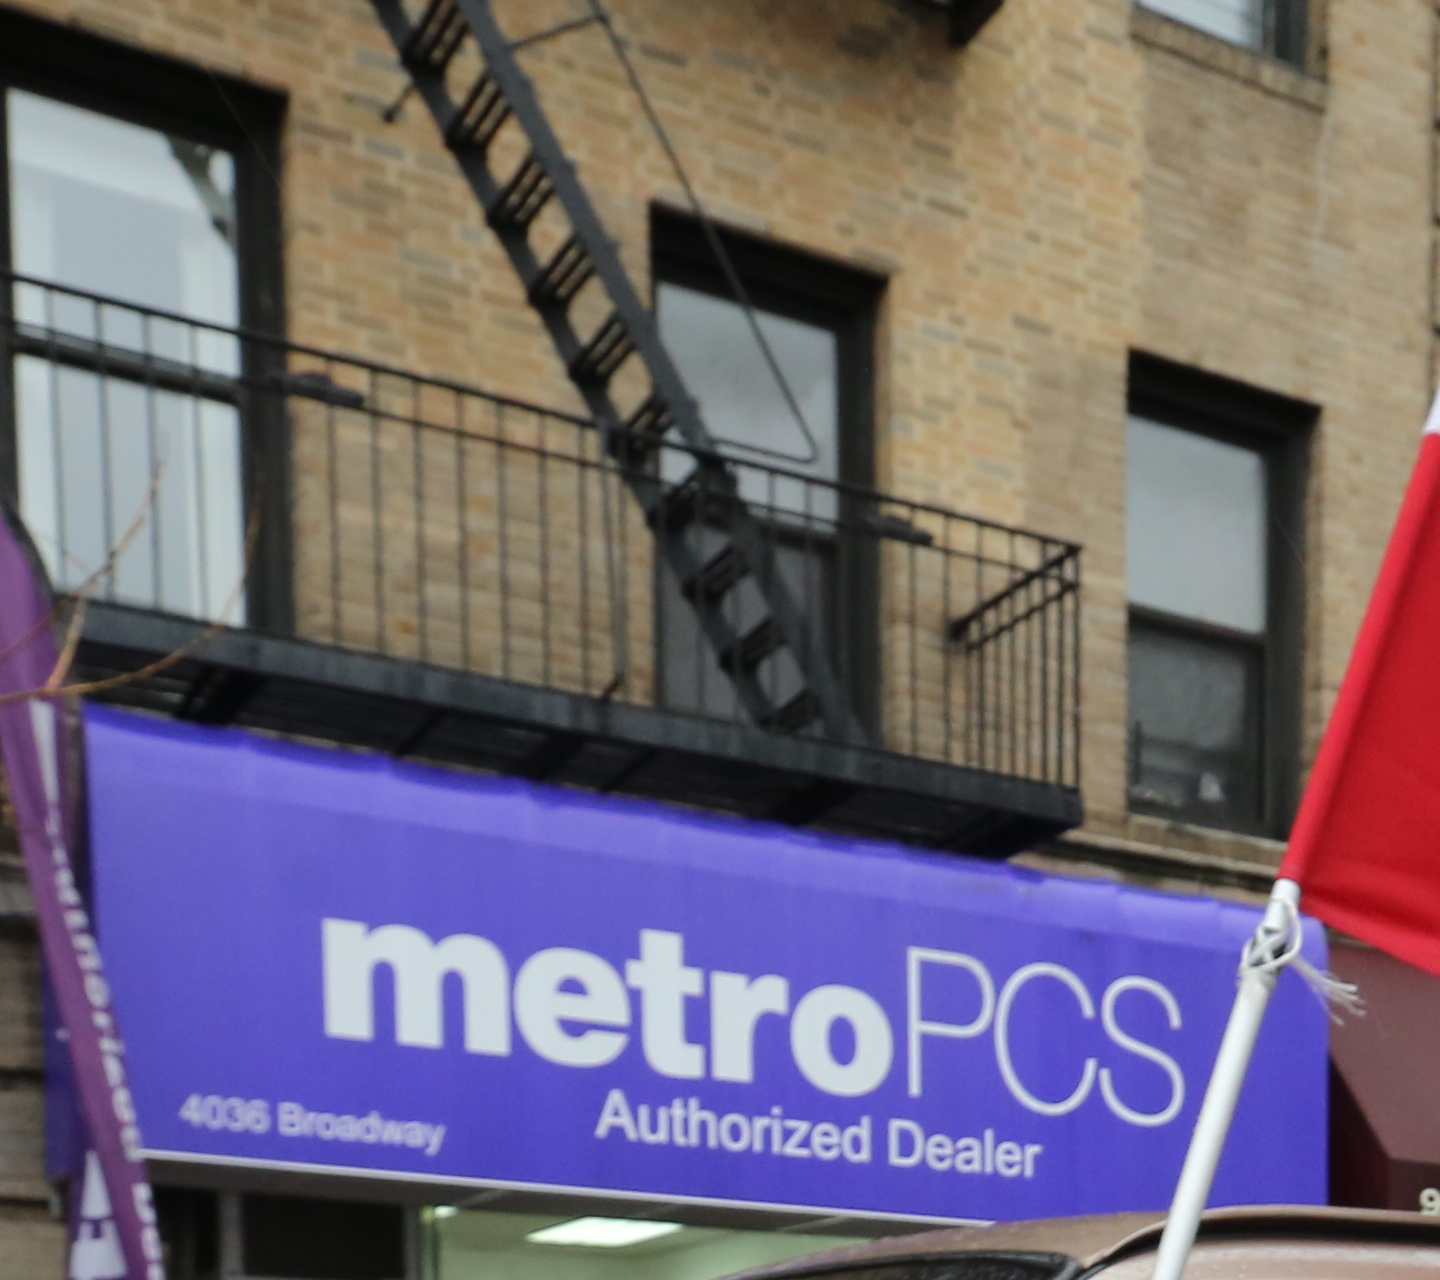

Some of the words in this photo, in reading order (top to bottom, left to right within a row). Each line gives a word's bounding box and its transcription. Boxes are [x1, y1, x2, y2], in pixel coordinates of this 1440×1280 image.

[320, 916, 1186, 1128] metroPCS
[177, 1092, 272, 1135] 4036
[276, 1100, 447, 1157] Broadway
[594, 1087, 872, 1164] Authorized
[887, 1117, 1044, 1179] Dealer
